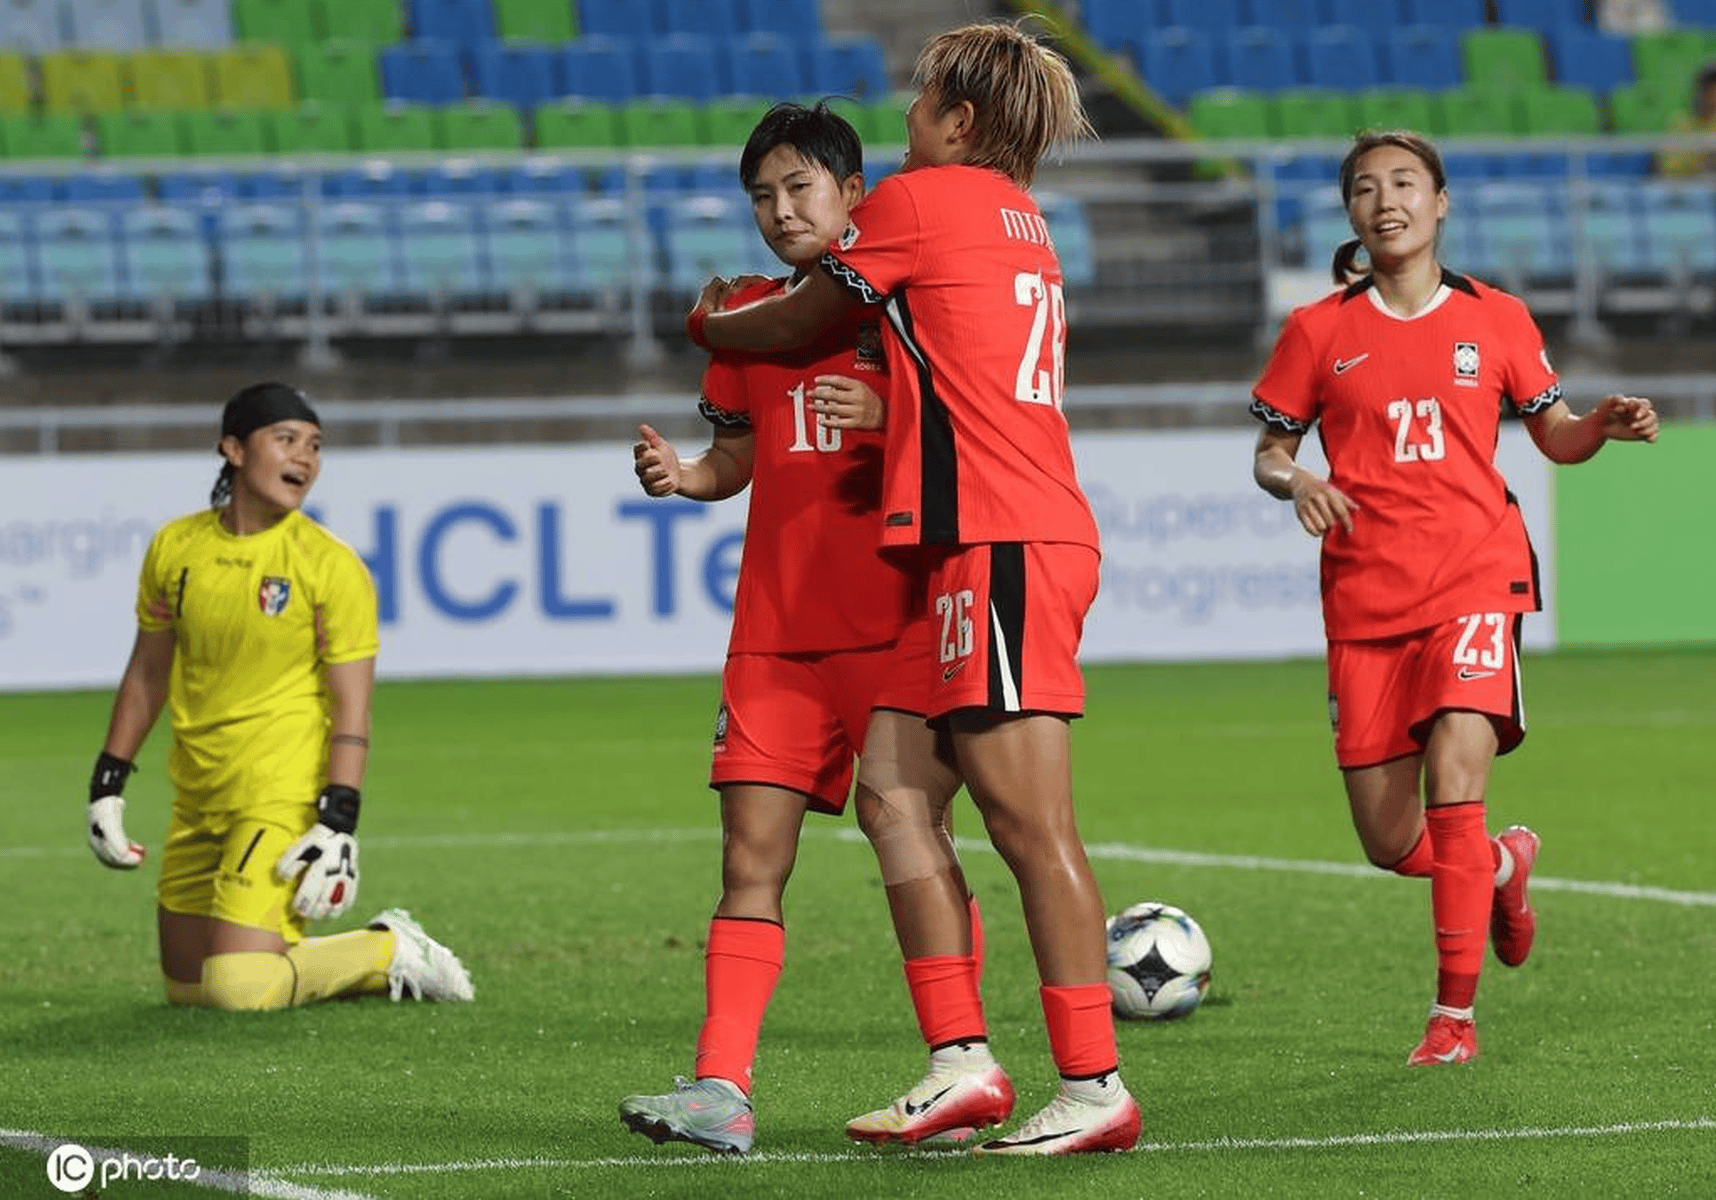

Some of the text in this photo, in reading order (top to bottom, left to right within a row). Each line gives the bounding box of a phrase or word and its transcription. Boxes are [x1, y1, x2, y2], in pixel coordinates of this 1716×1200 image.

[1387, 396, 1445, 463] 23
[176, 567, 188, 618] 1
[936, 590, 974, 663] 26
[1453, 612, 1506, 669] 23
